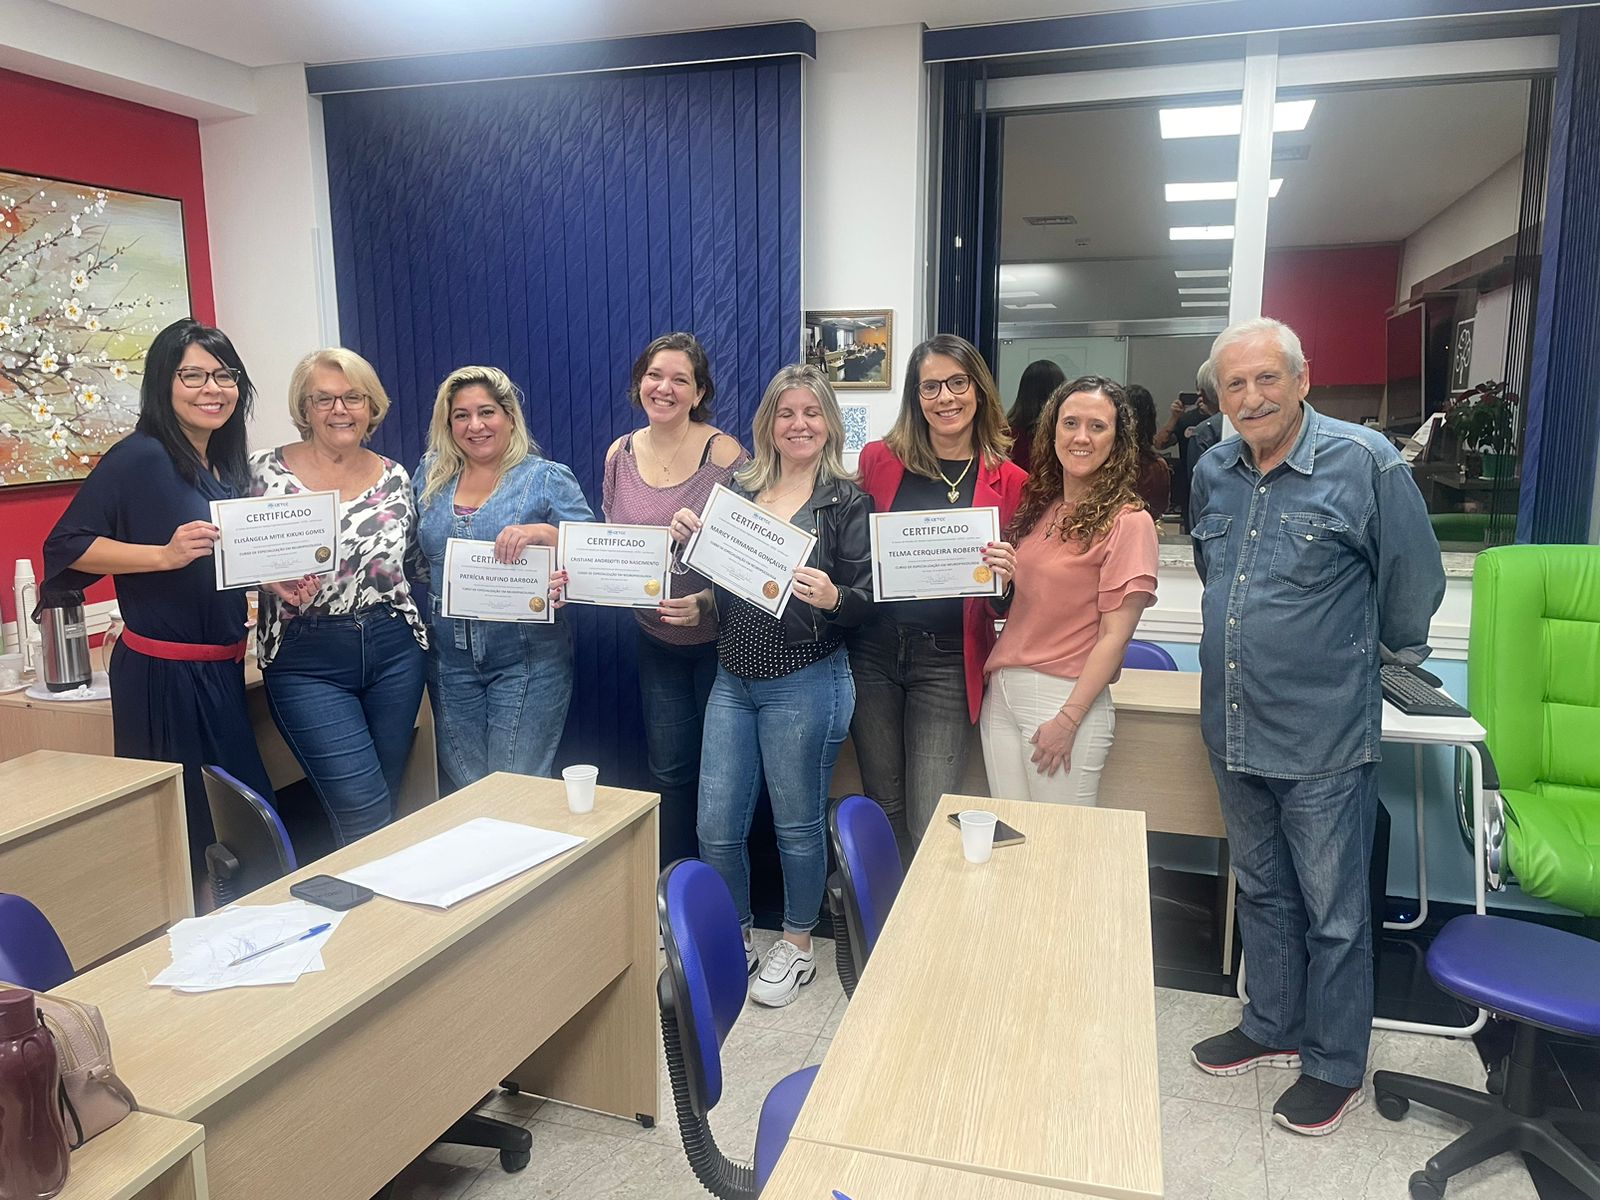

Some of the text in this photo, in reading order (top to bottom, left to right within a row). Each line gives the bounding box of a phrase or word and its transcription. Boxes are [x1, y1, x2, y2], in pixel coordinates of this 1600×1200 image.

[246, 508, 312, 523] CERTIFICADO
[731, 511, 785, 546] CERTIFICADO
[902, 525, 969, 537] CERTIFICADO
[234, 534, 268, 544] ELISÂNGELA
[587, 537, 645, 548] CERTIFICADO
[710, 525, 730, 540] MARICY
[730, 537, 758, 555] FERNANDA
[757, 552, 788, 573] GONÇALVES
[913, 548, 951, 556] CERQUEIRA
